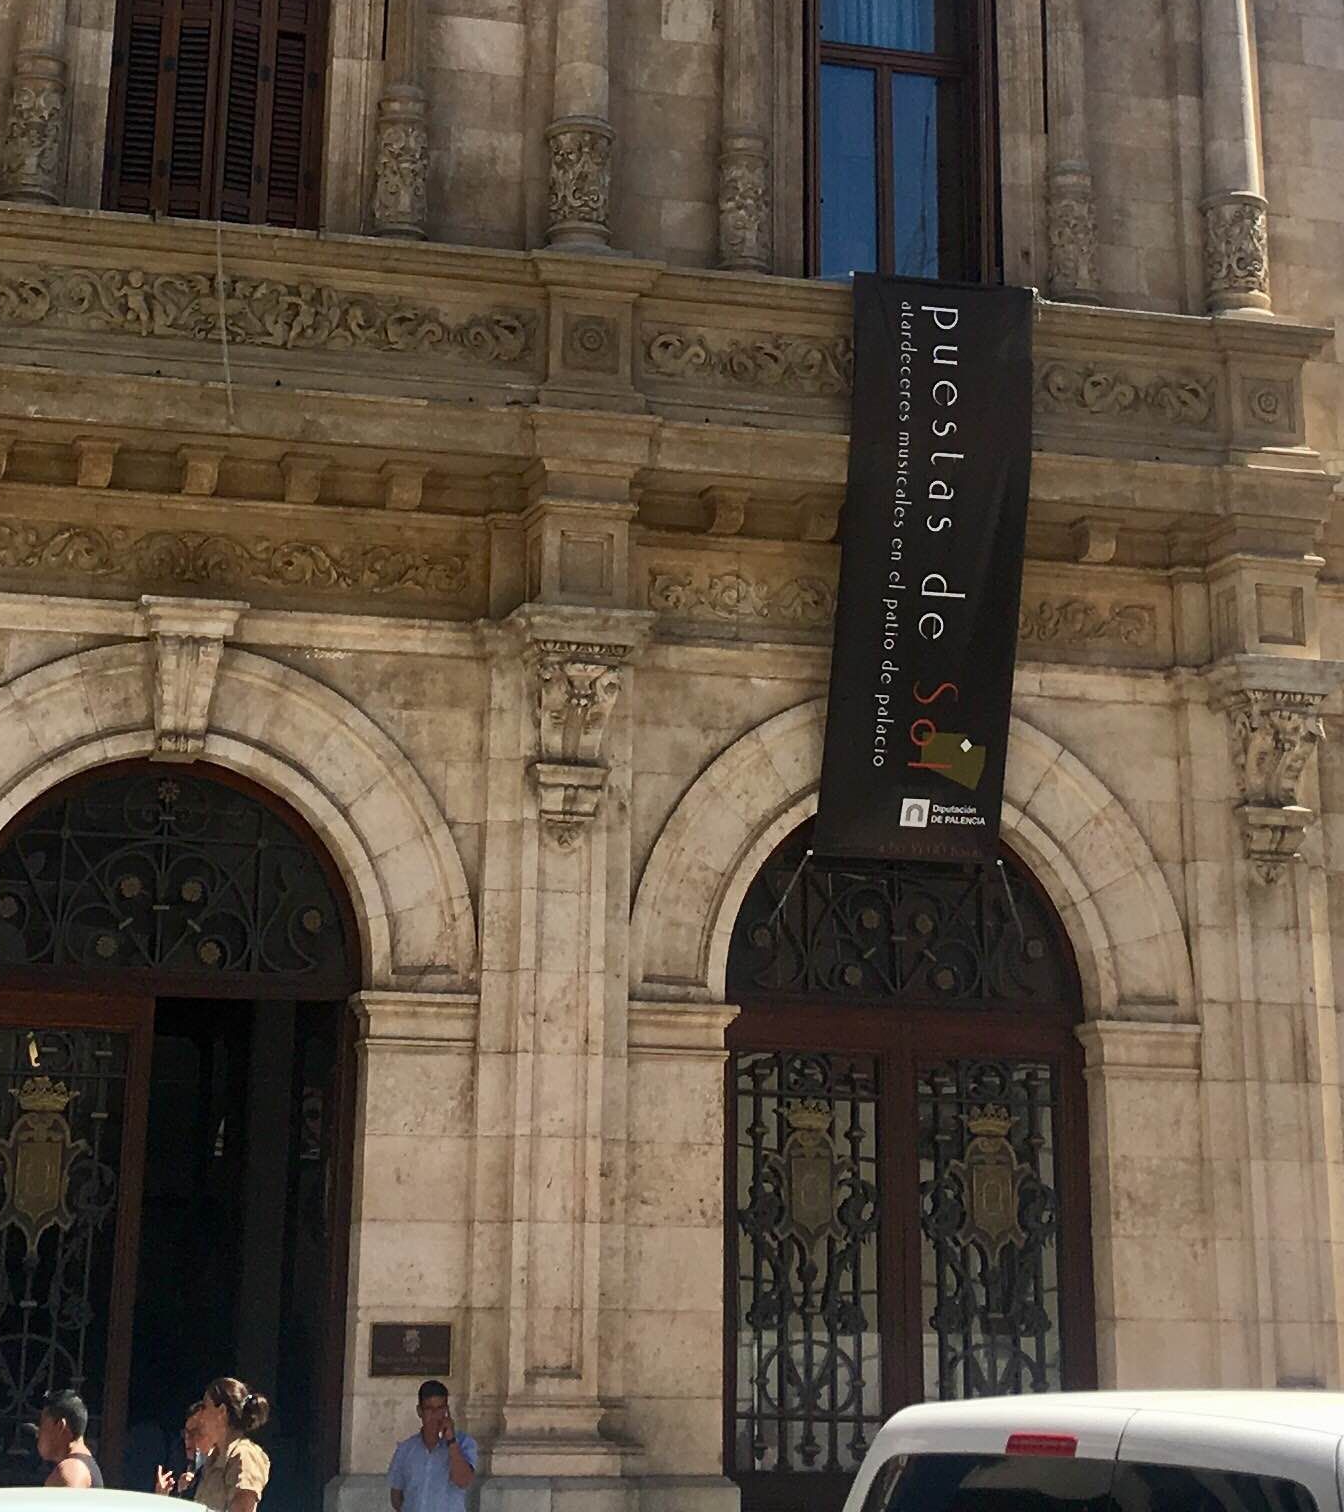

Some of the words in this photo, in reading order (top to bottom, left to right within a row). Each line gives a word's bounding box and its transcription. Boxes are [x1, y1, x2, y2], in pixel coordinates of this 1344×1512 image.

[898, 301, 918, 422] atardeceres
[921, 305, 964, 532] puestas
[893, 431, 913, 528] musicales
[888, 571, 906, 589] el
[890, 538, 904, 561] en
[882, 598, 899, 650] patio
[918, 573, 966, 640] de
[880, 660, 900, 684] de
[872, 694, 895, 767] palacio
[906, 679, 959, 772] Sol
[930, 815, 943, 824] DE
[944, 815, 986, 826] PALENCIA
